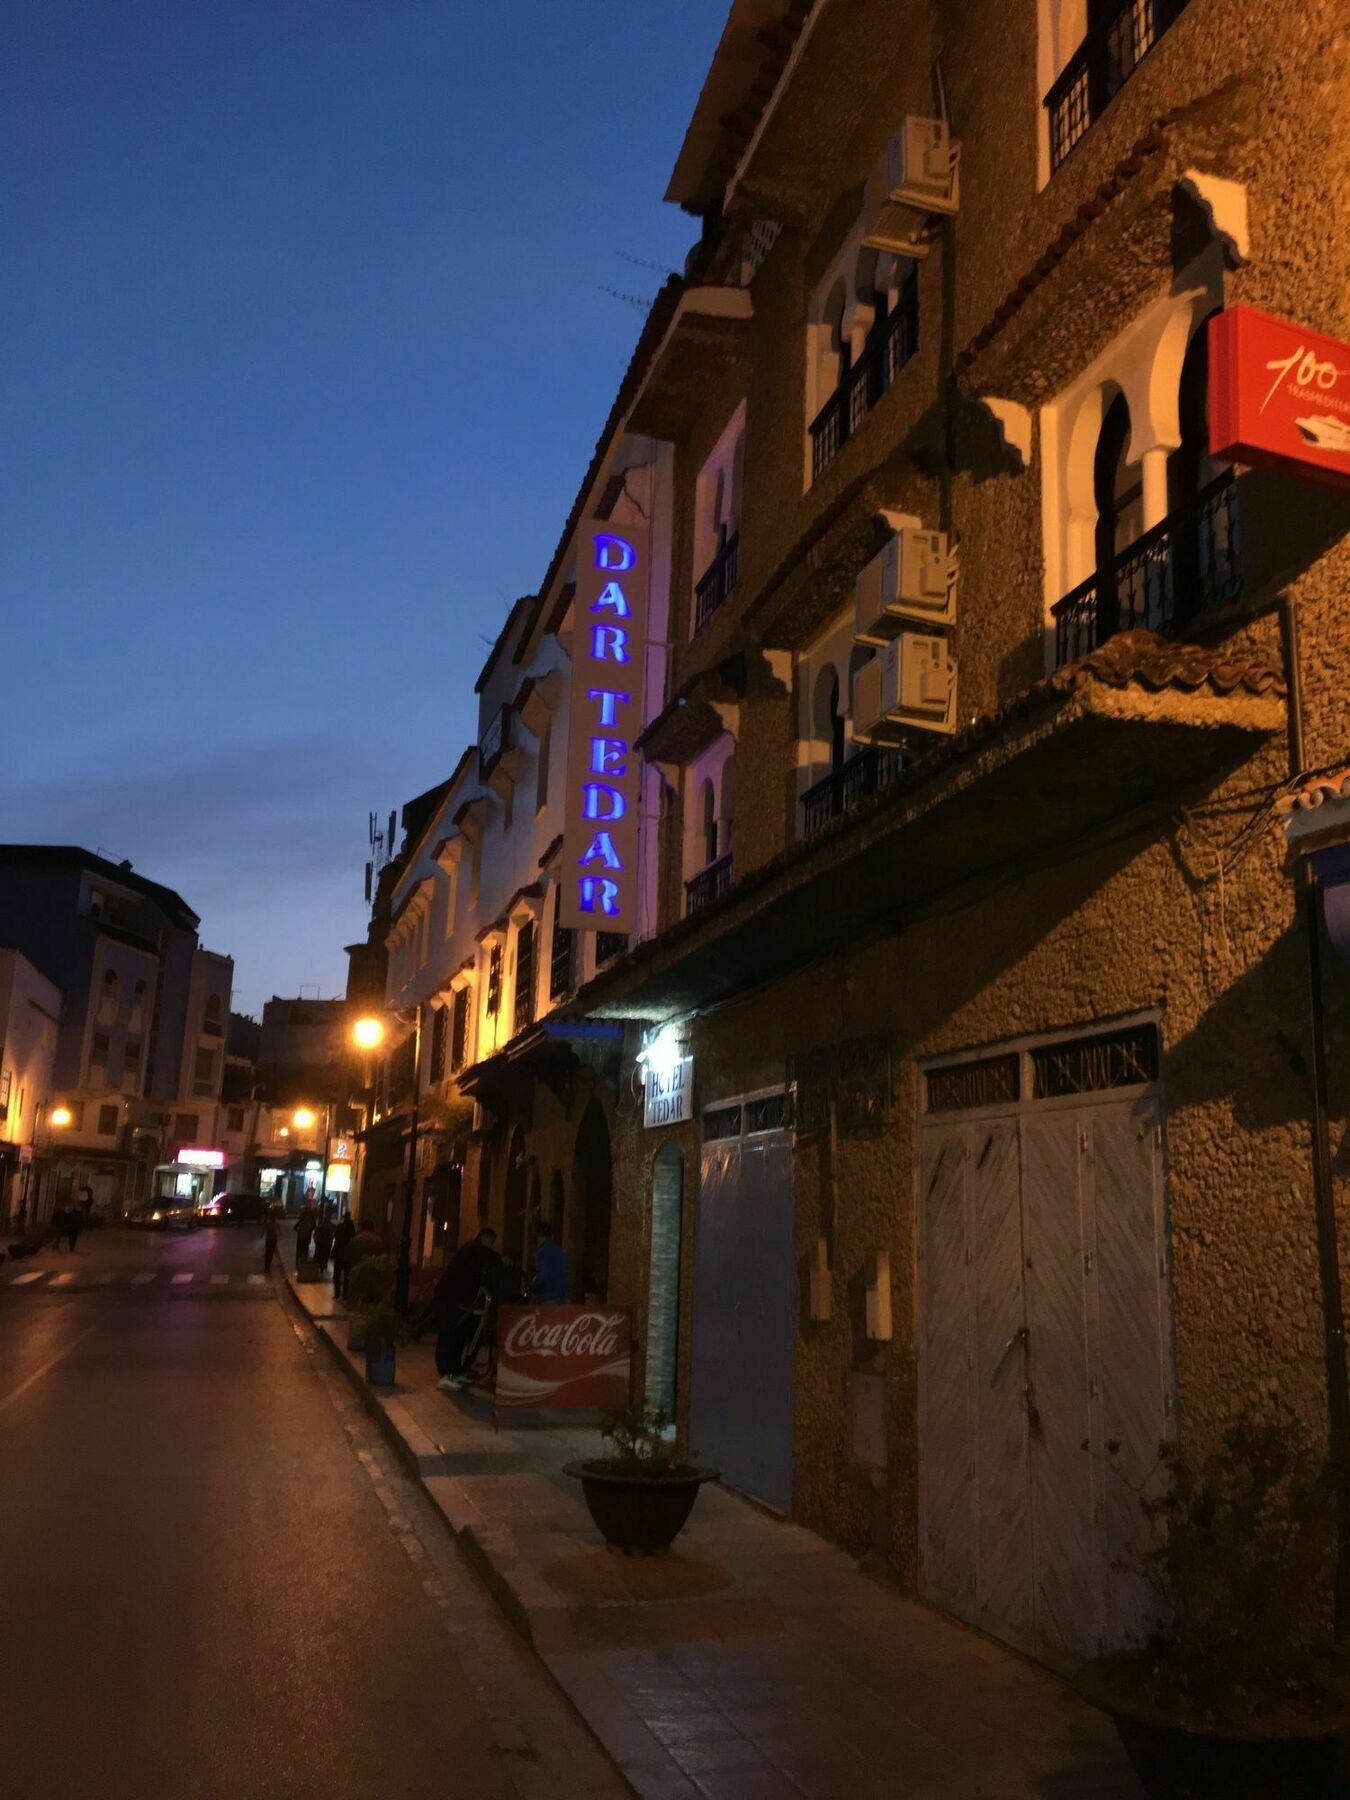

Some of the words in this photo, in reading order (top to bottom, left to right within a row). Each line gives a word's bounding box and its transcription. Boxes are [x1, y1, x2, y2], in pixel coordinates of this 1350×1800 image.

[592, 534, 635, 661] DAR
[579, 690, 630, 916] TEDAR
[651, 1096, 683, 1124] TEDAR
[505, 1313, 625, 1357] Coca-Cola
